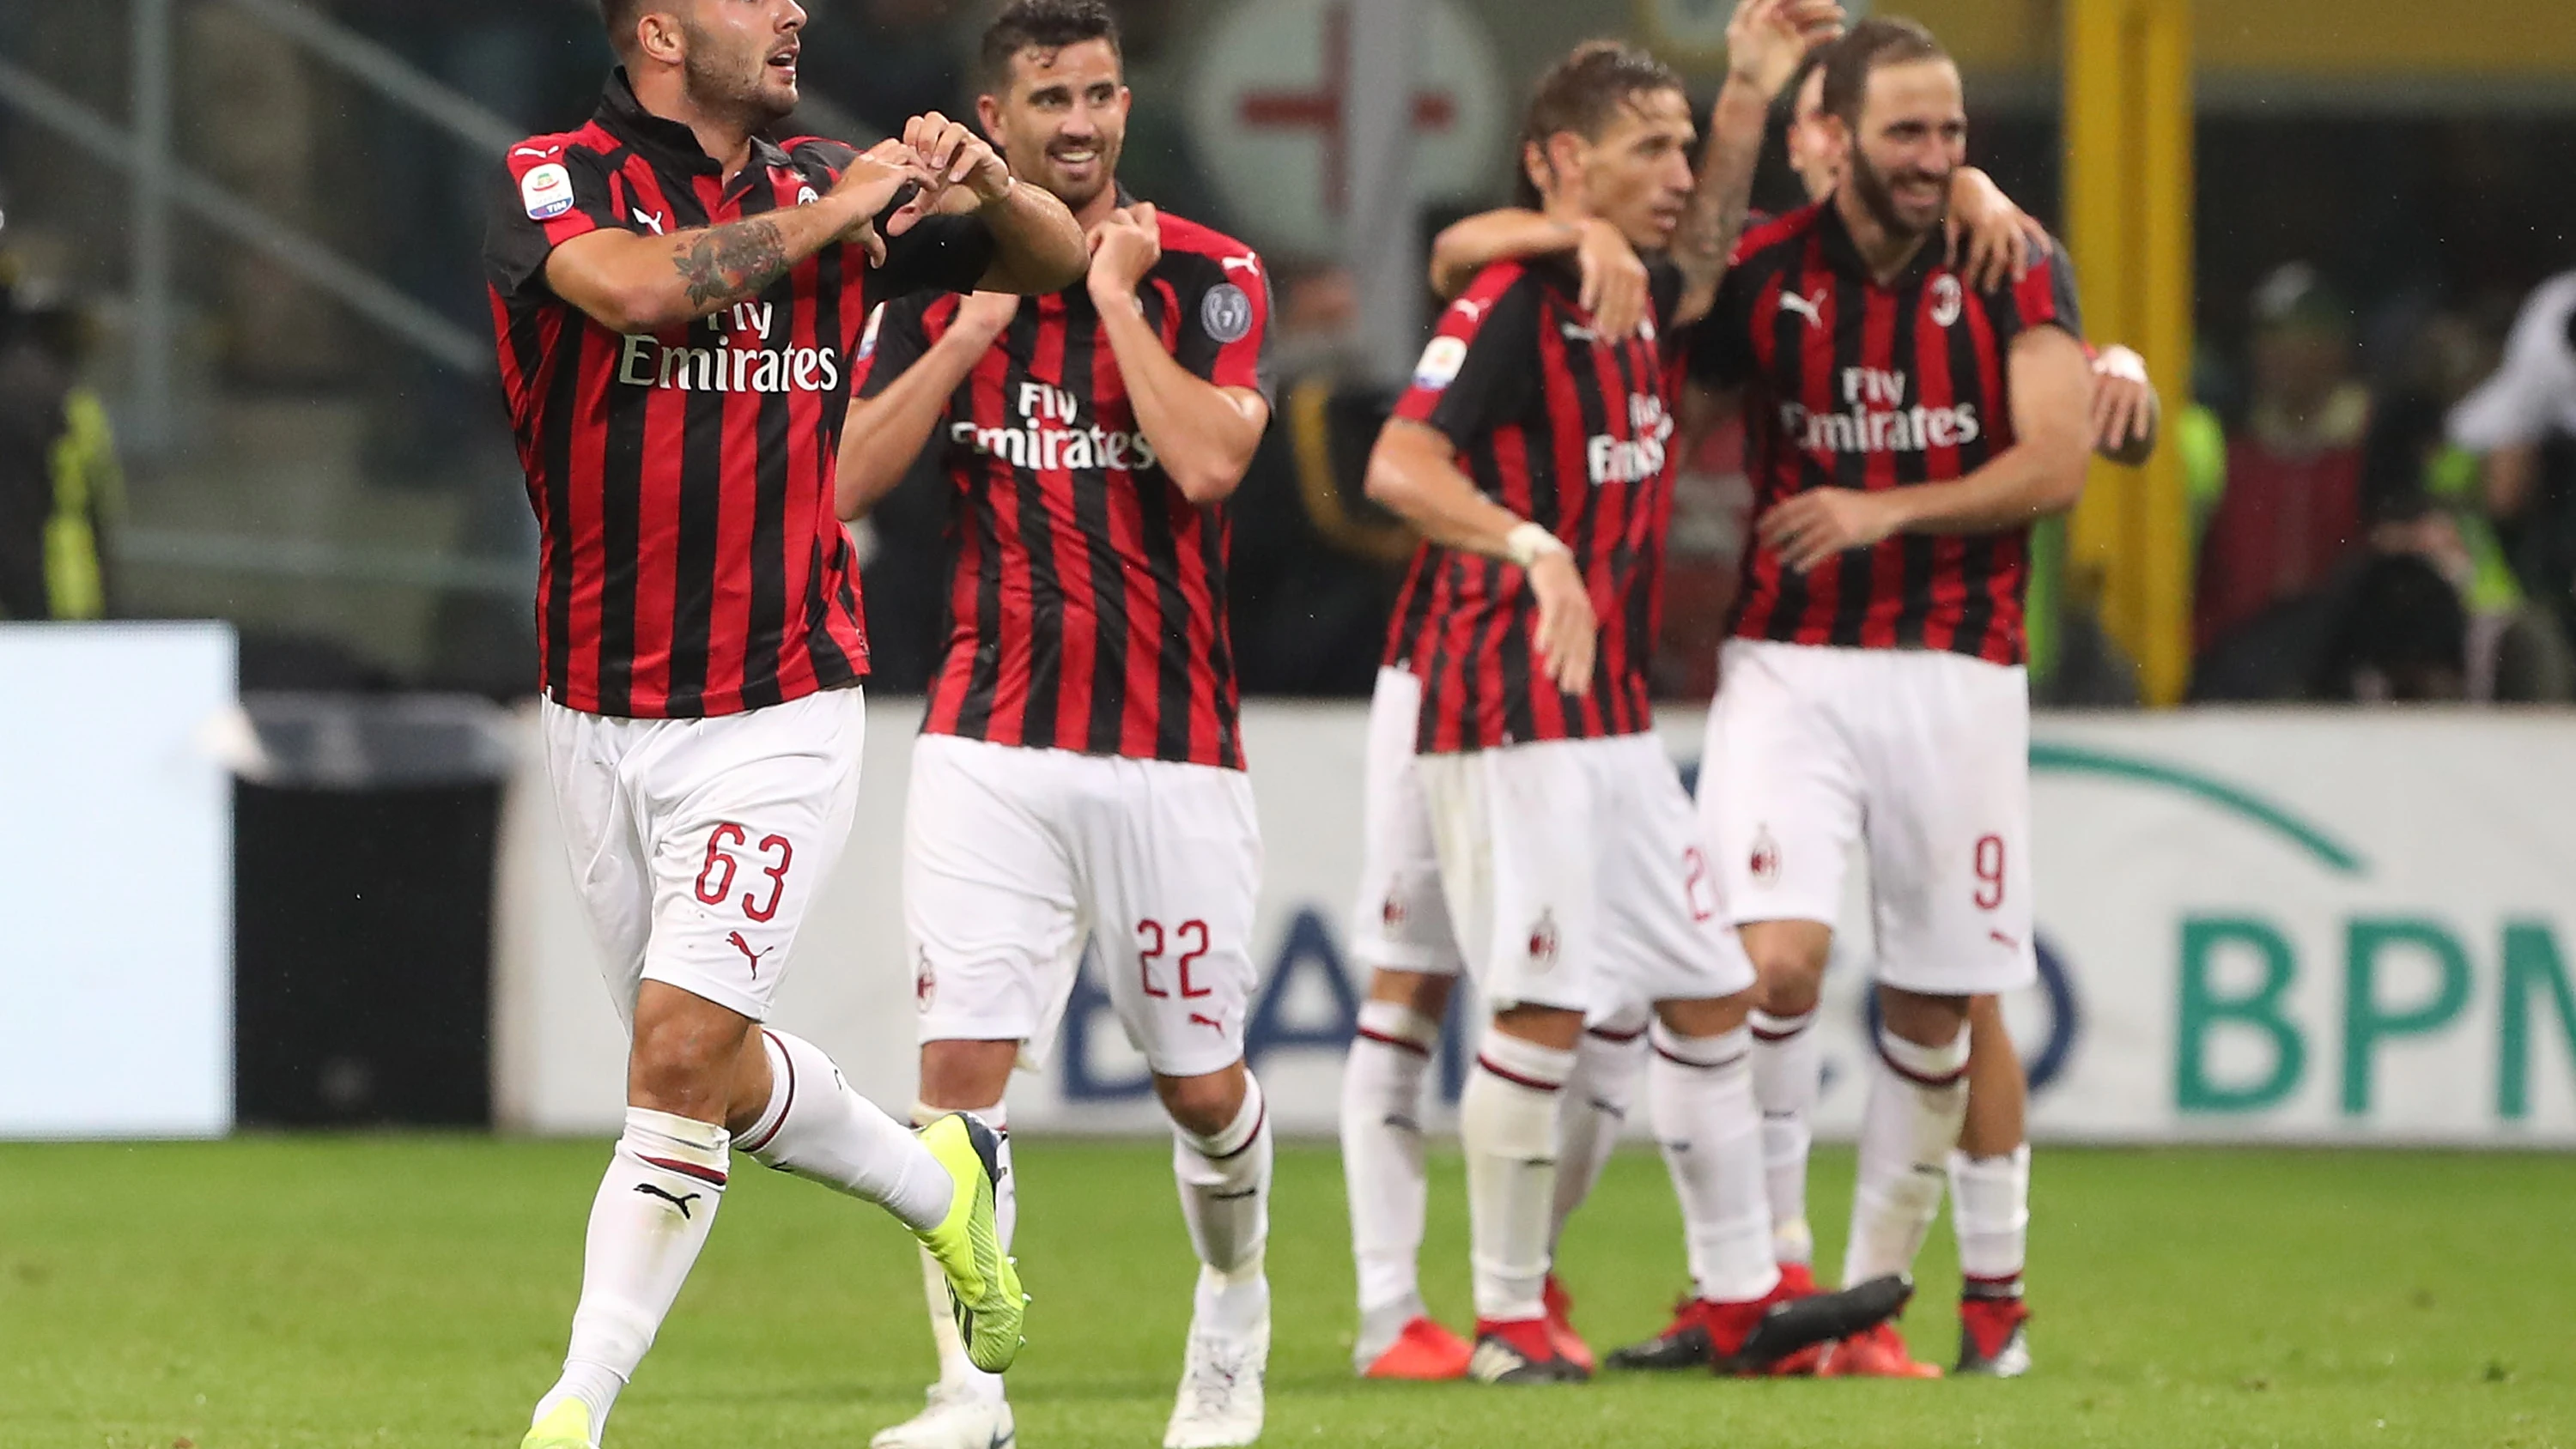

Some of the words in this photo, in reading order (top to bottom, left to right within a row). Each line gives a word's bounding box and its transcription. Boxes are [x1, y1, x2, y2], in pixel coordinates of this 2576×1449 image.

[618, 333, 839, 392] Emirates
[1018, 381, 1078, 425] Fly
[695, 822, 793, 924] 63
[1974, 835, 2004, 912] 9
[1137, 919, 1212, 999] 22
